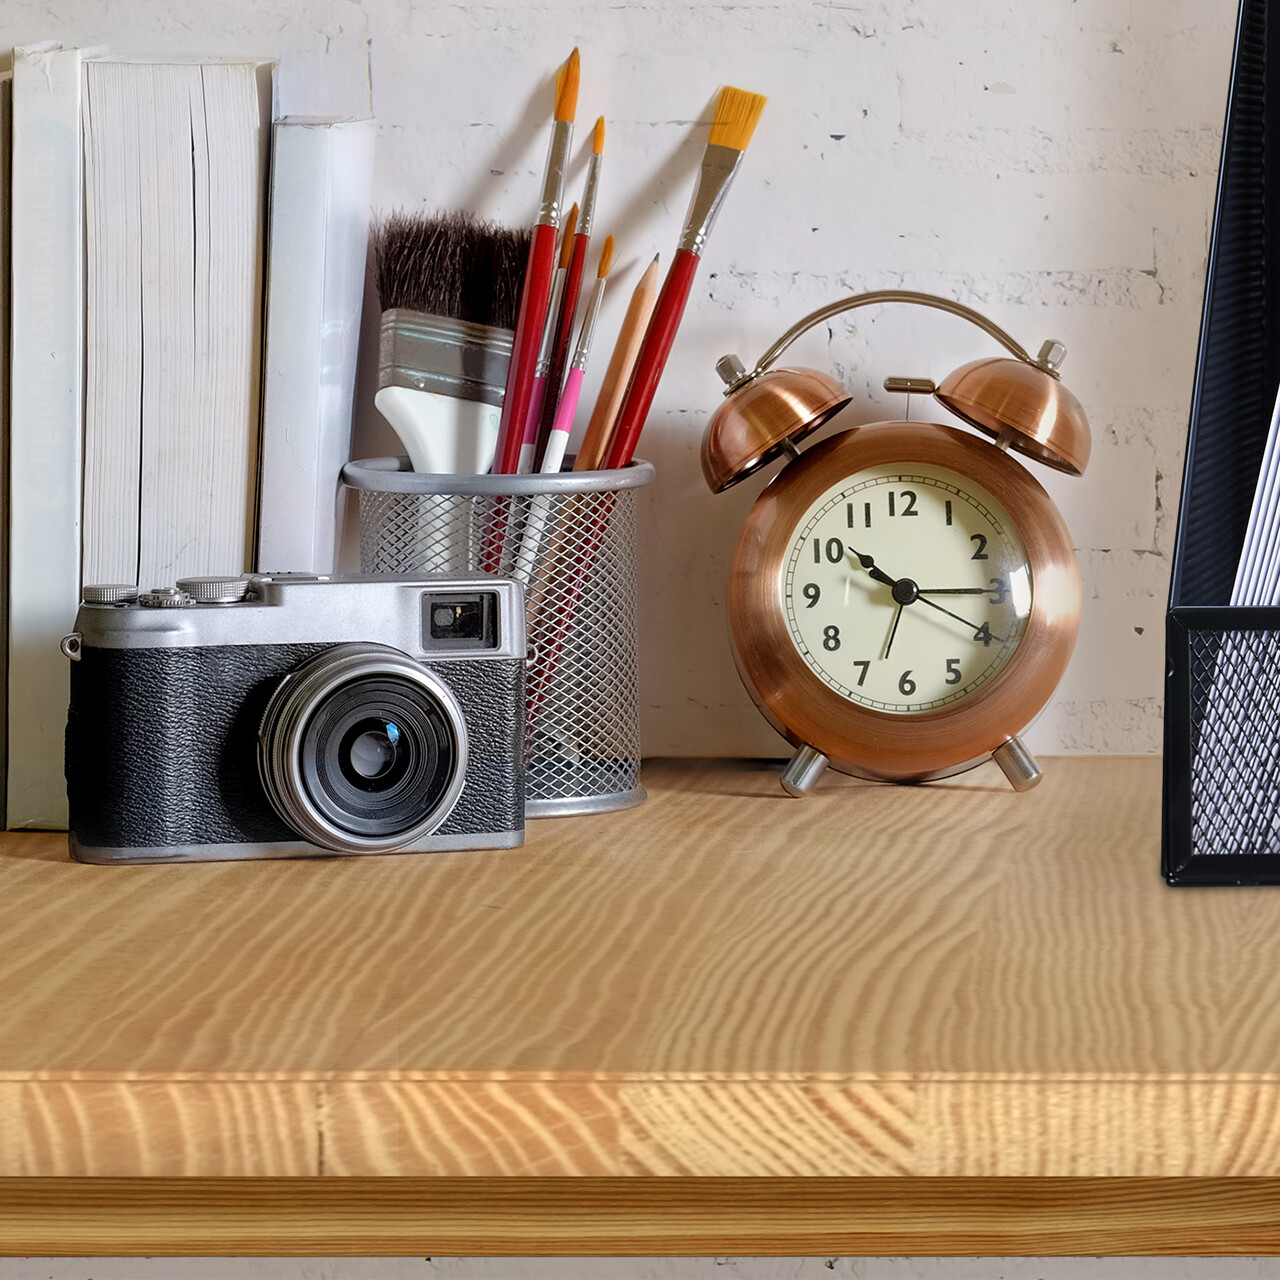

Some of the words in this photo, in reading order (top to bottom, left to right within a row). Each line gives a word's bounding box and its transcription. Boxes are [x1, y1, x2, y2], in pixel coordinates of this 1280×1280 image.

[847, 502, 872, 528] 11
[888, 491, 918, 517] 12
[813, 537, 844, 564] 10
[970, 534, 989, 560] 2
[803, 582, 821, 609] 9
[988, 578, 1007, 605] 3
[822, 625, 841, 651] 8
[973, 621, 992, 648] 4
[853, 660, 872, 687] 7
[897, 669, 917, 696] 6
[945, 658, 962, 685] 5
